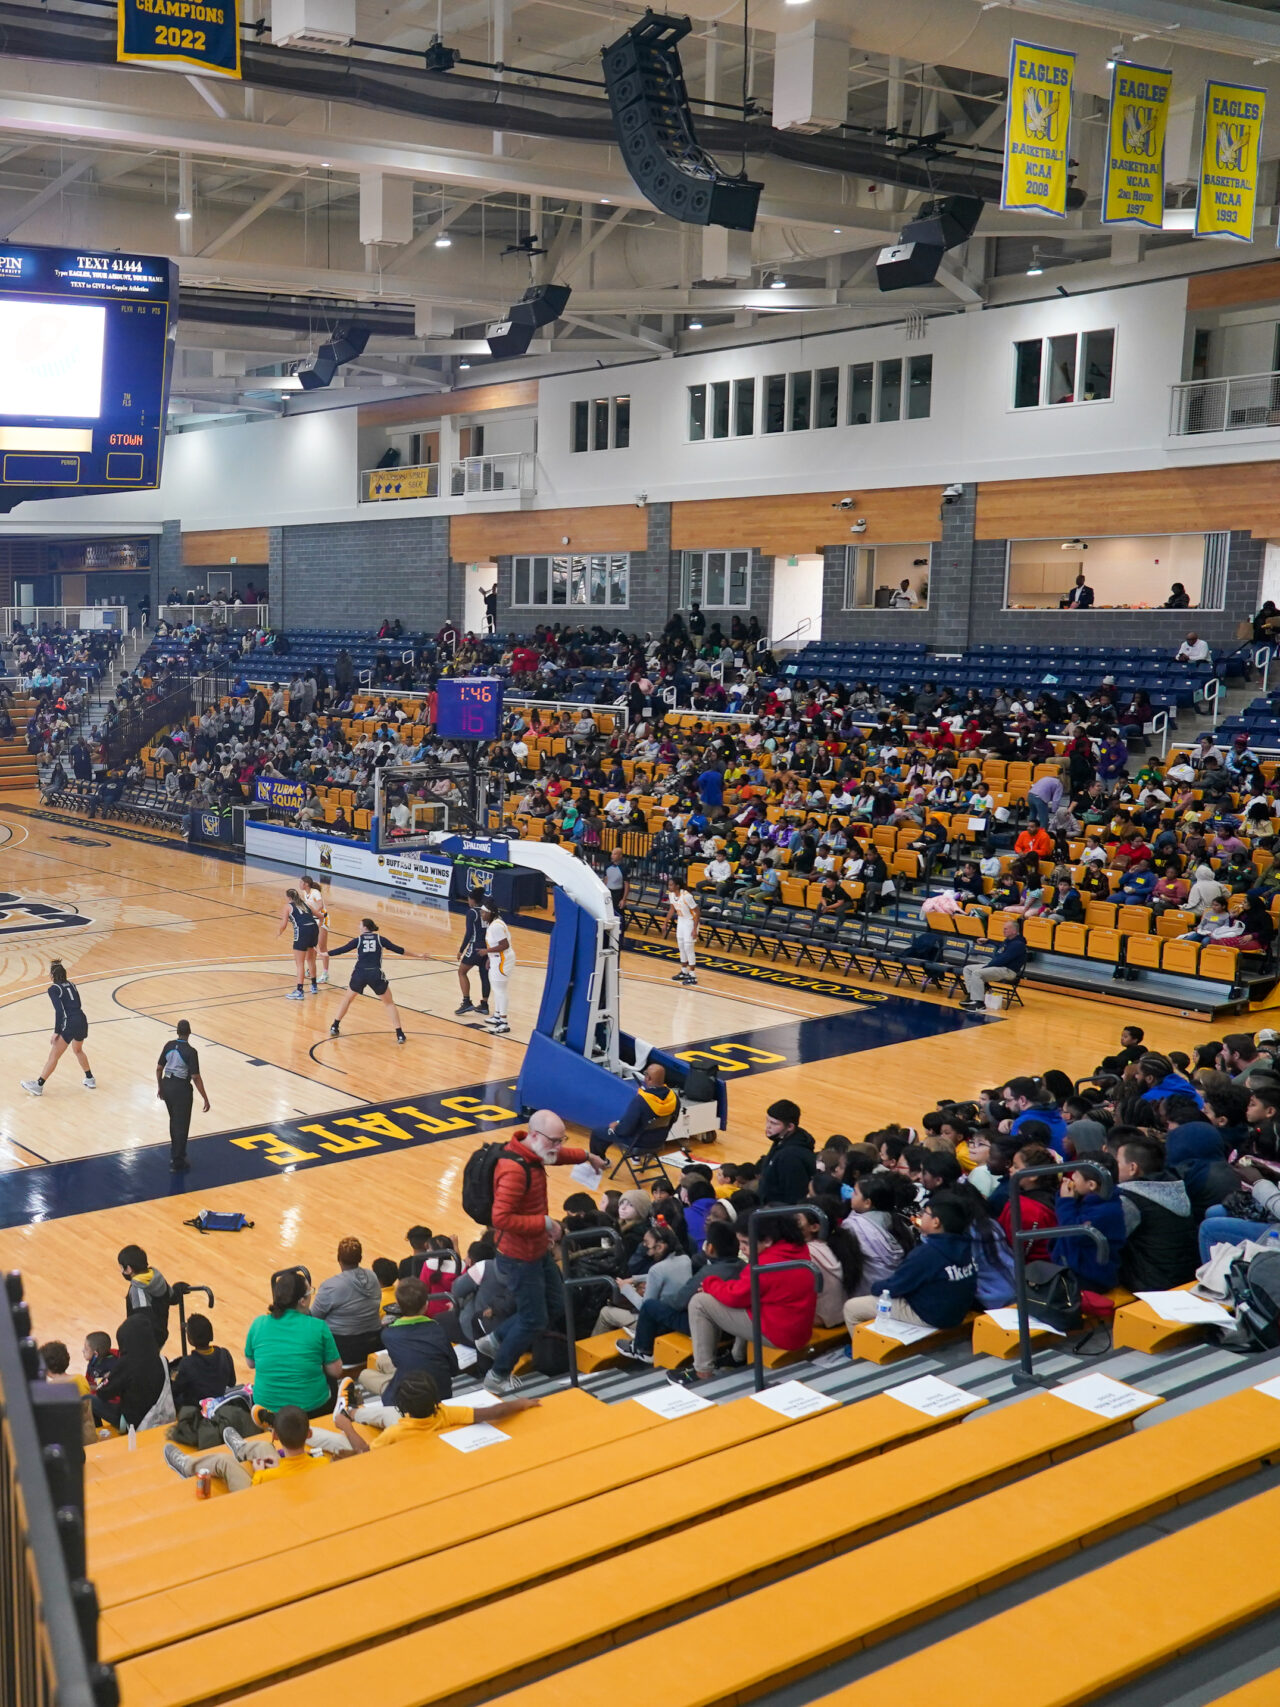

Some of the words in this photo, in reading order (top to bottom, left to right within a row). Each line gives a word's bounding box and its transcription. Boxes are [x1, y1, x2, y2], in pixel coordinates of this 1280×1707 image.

[135, 0, 224, 24] CHAMPIONS
[155, 25, 206, 50] 2022
[1019, 60, 1068, 86] EAGLES
[1119, 79, 1168, 103] EAGLES
[1213, 97, 1260, 120] EAGLES
[1025, 162, 1052, 179] NCAA
[1111, 158, 1160, 174] BASKETBA
[1026, 181, 1049, 197] 2008
[1215, 191, 1242, 206] NCAA
[1216, 209, 1237, 223] 1993
[77, 256, 109, 270] TEXT
[111, 259, 143, 273] 41444
[109, 434, 144, 446] GTOWN
[460, 686, 492, 702] 1:46
[462, 704, 484, 733] 16
[273, 783, 295, 795] TURN
[272, 794, 303, 808] SQUAD
[463, 840, 491, 854] SPALDING
[414, 863, 429, 873] WILD
[430, 867, 450, 878] WINGS
[363, 940, 376, 952] 33
[229, 1095, 519, 1166] STATE
